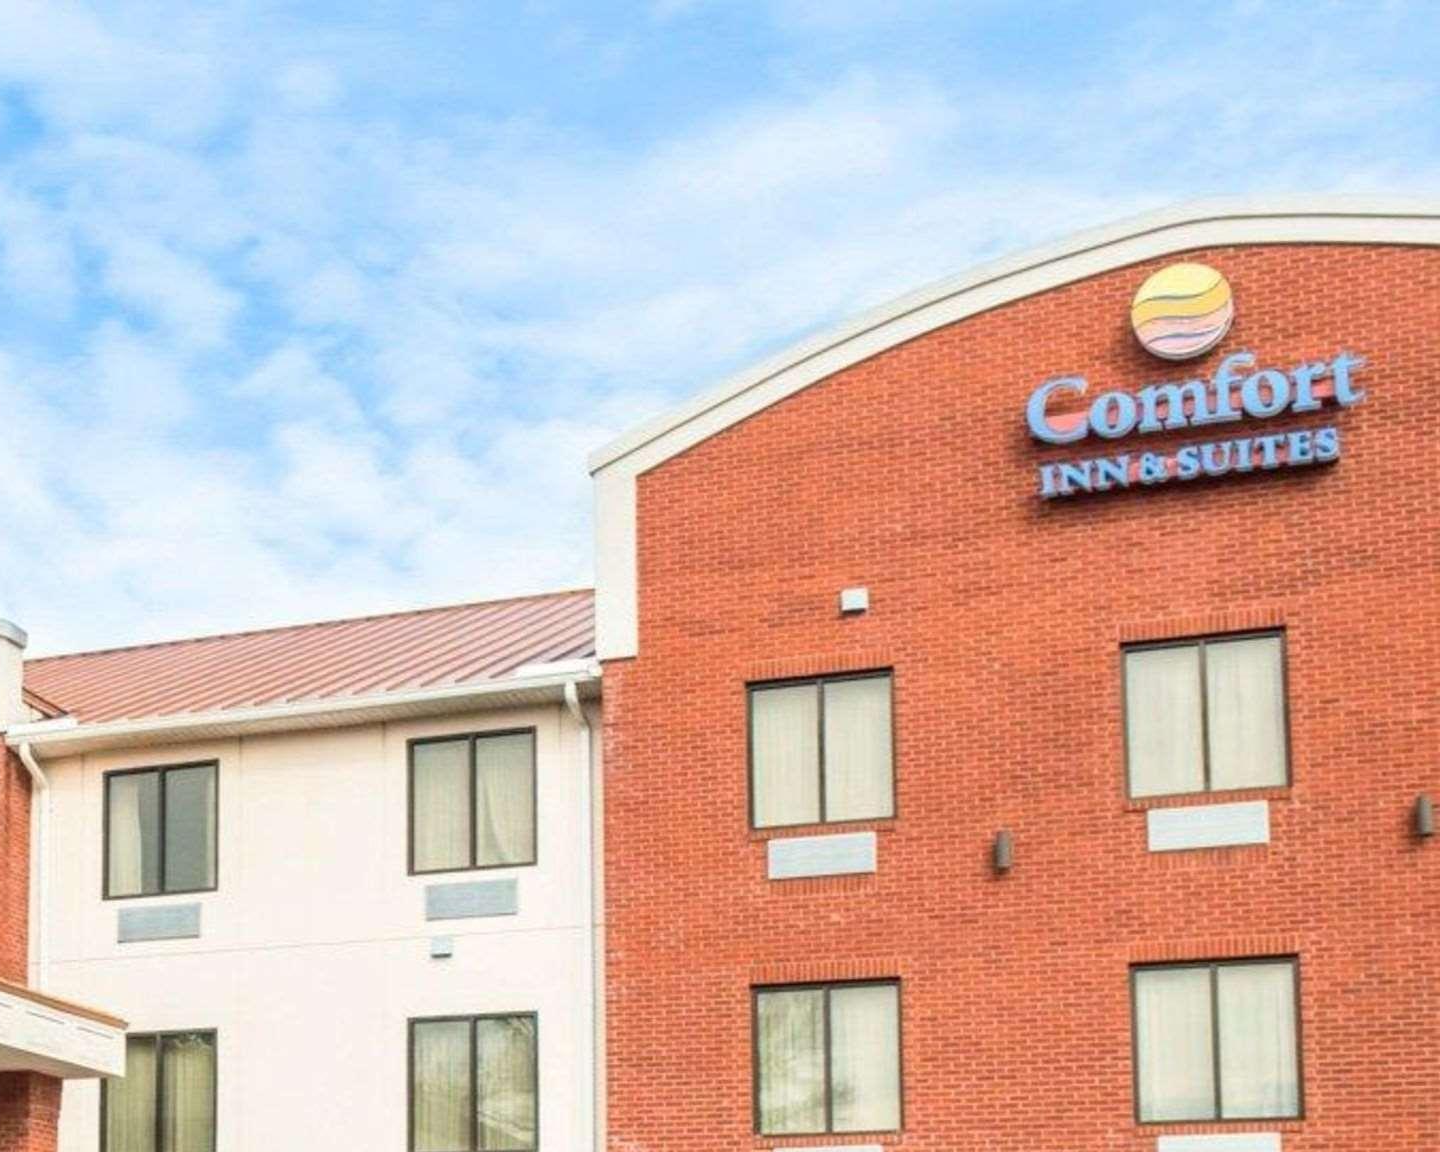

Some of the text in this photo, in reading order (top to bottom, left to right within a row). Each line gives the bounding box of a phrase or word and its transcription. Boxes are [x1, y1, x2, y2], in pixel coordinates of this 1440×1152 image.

[1025, 349, 1366, 443] Comfort
[1040, 427, 1340, 498] INN & SUITES
